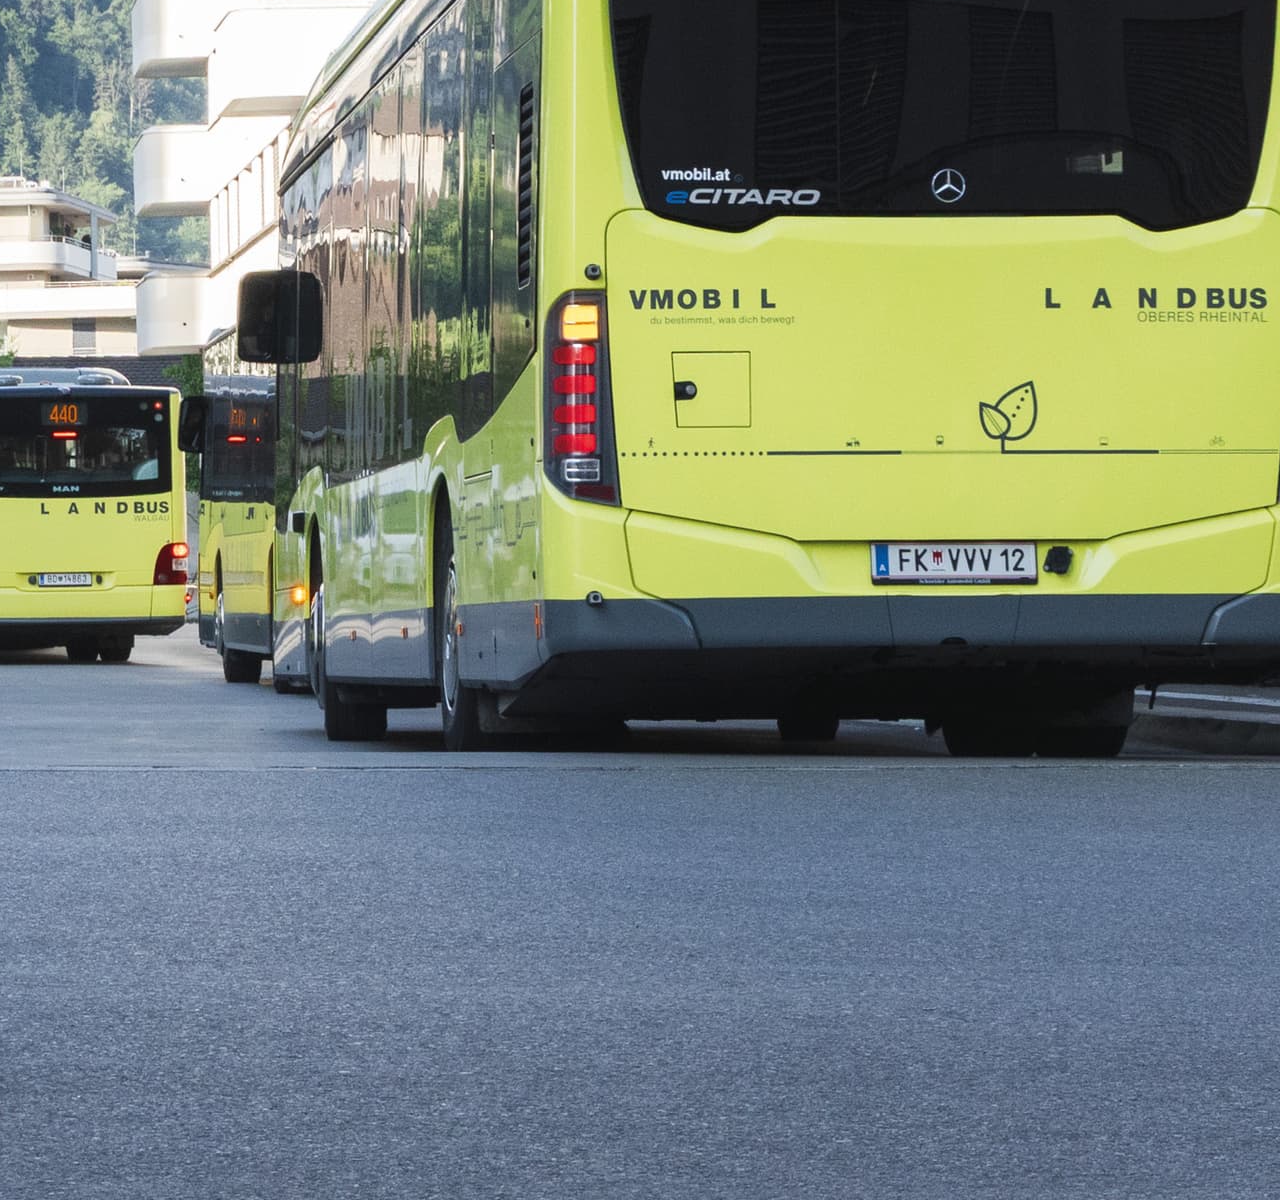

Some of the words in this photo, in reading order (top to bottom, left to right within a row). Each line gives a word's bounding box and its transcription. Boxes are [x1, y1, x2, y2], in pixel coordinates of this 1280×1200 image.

[661, 167, 731, 181] vmobil.at
[666, 188, 821, 205] eCITARO
[629, 288, 776, 309] VMOBIL
[1045, 288, 1267, 309] LANDBUS
[650, 316, 662, 324] du
[664, 316, 715, 326] bestimmst,
[739, 315, 758, 324] dich
[760, 315, 795, 325] bewegt
[1137, 311, 1194, 322] OBERES
[1200, 311, 1268, 322] RHEINTAL
[49, 404, 79, 424] 440
[41, 501, 169, 514] LANDBUS
[899, 548, 928, 572] FK
[948, 548, 992, 572] VVV
[1000, 548, 1025, 572] 12
